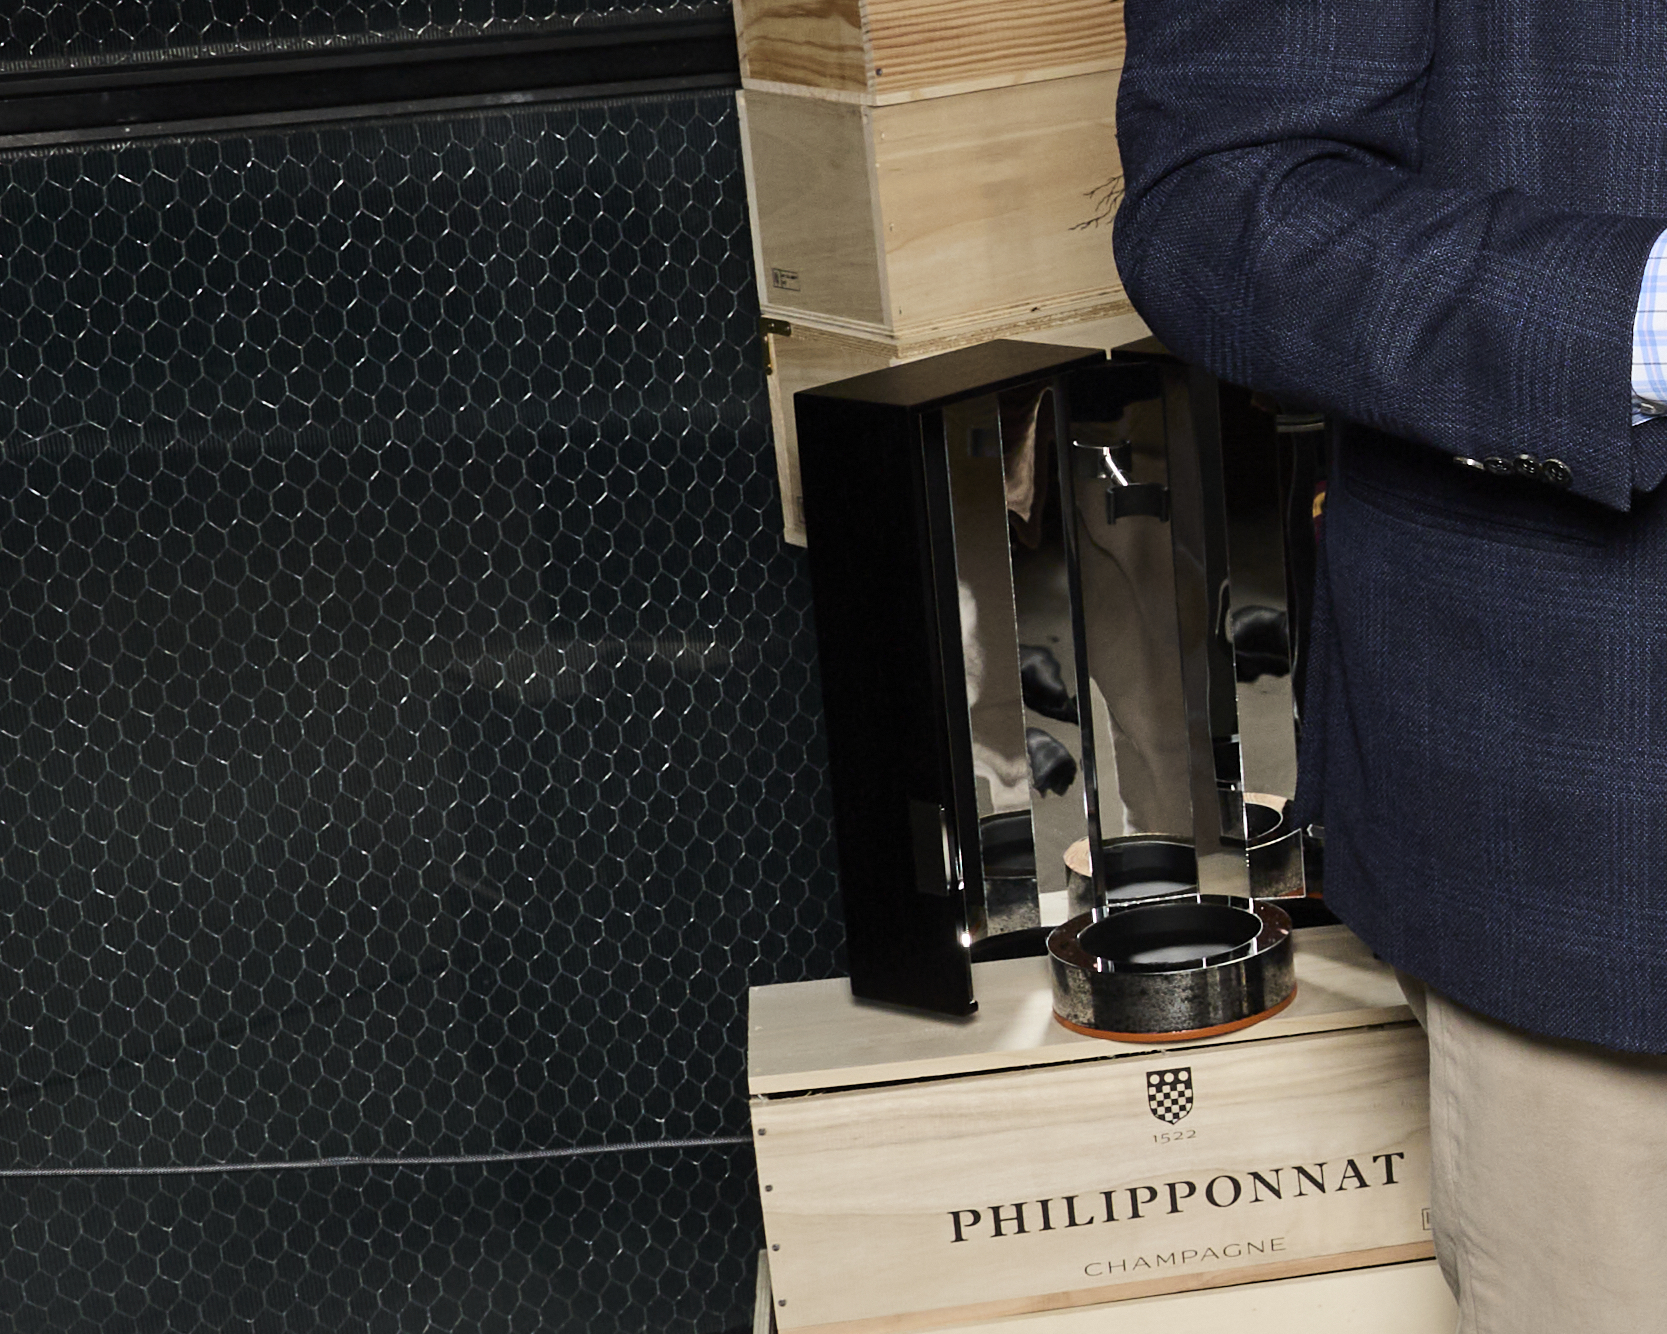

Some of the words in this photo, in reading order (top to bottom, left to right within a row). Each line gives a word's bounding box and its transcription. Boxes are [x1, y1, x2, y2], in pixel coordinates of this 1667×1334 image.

[1152, 1129, 1197, 1144] 1522
[948, 1151, 1405, 1243] PHILIPPONNAT
[1084, 1236, 1287, 1277] CHAMPAGNE
